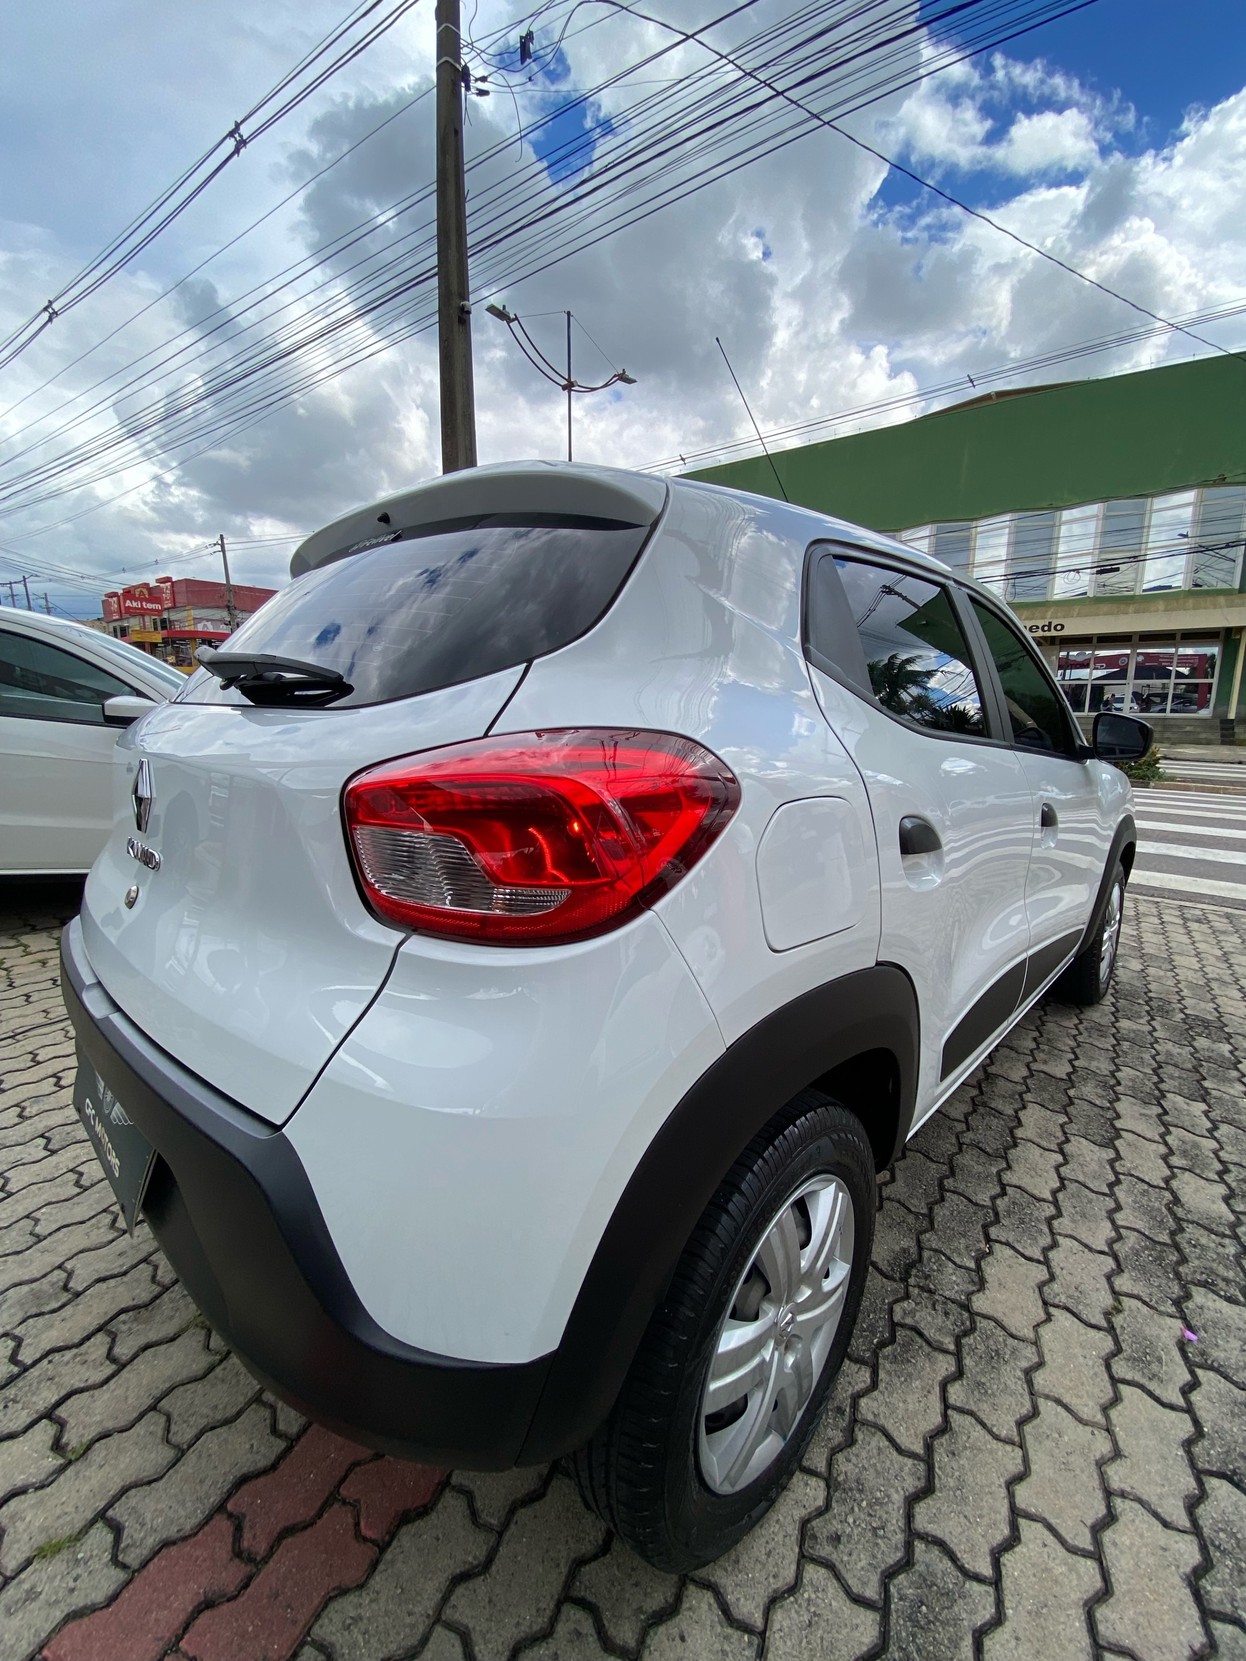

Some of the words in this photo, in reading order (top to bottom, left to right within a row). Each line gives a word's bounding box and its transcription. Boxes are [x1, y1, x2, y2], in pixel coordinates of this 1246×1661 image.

[125, 600, 141, 608] Aki
[142, 601, 161, 610] tem
[94, 1116, 121, 1178] MOTORS
